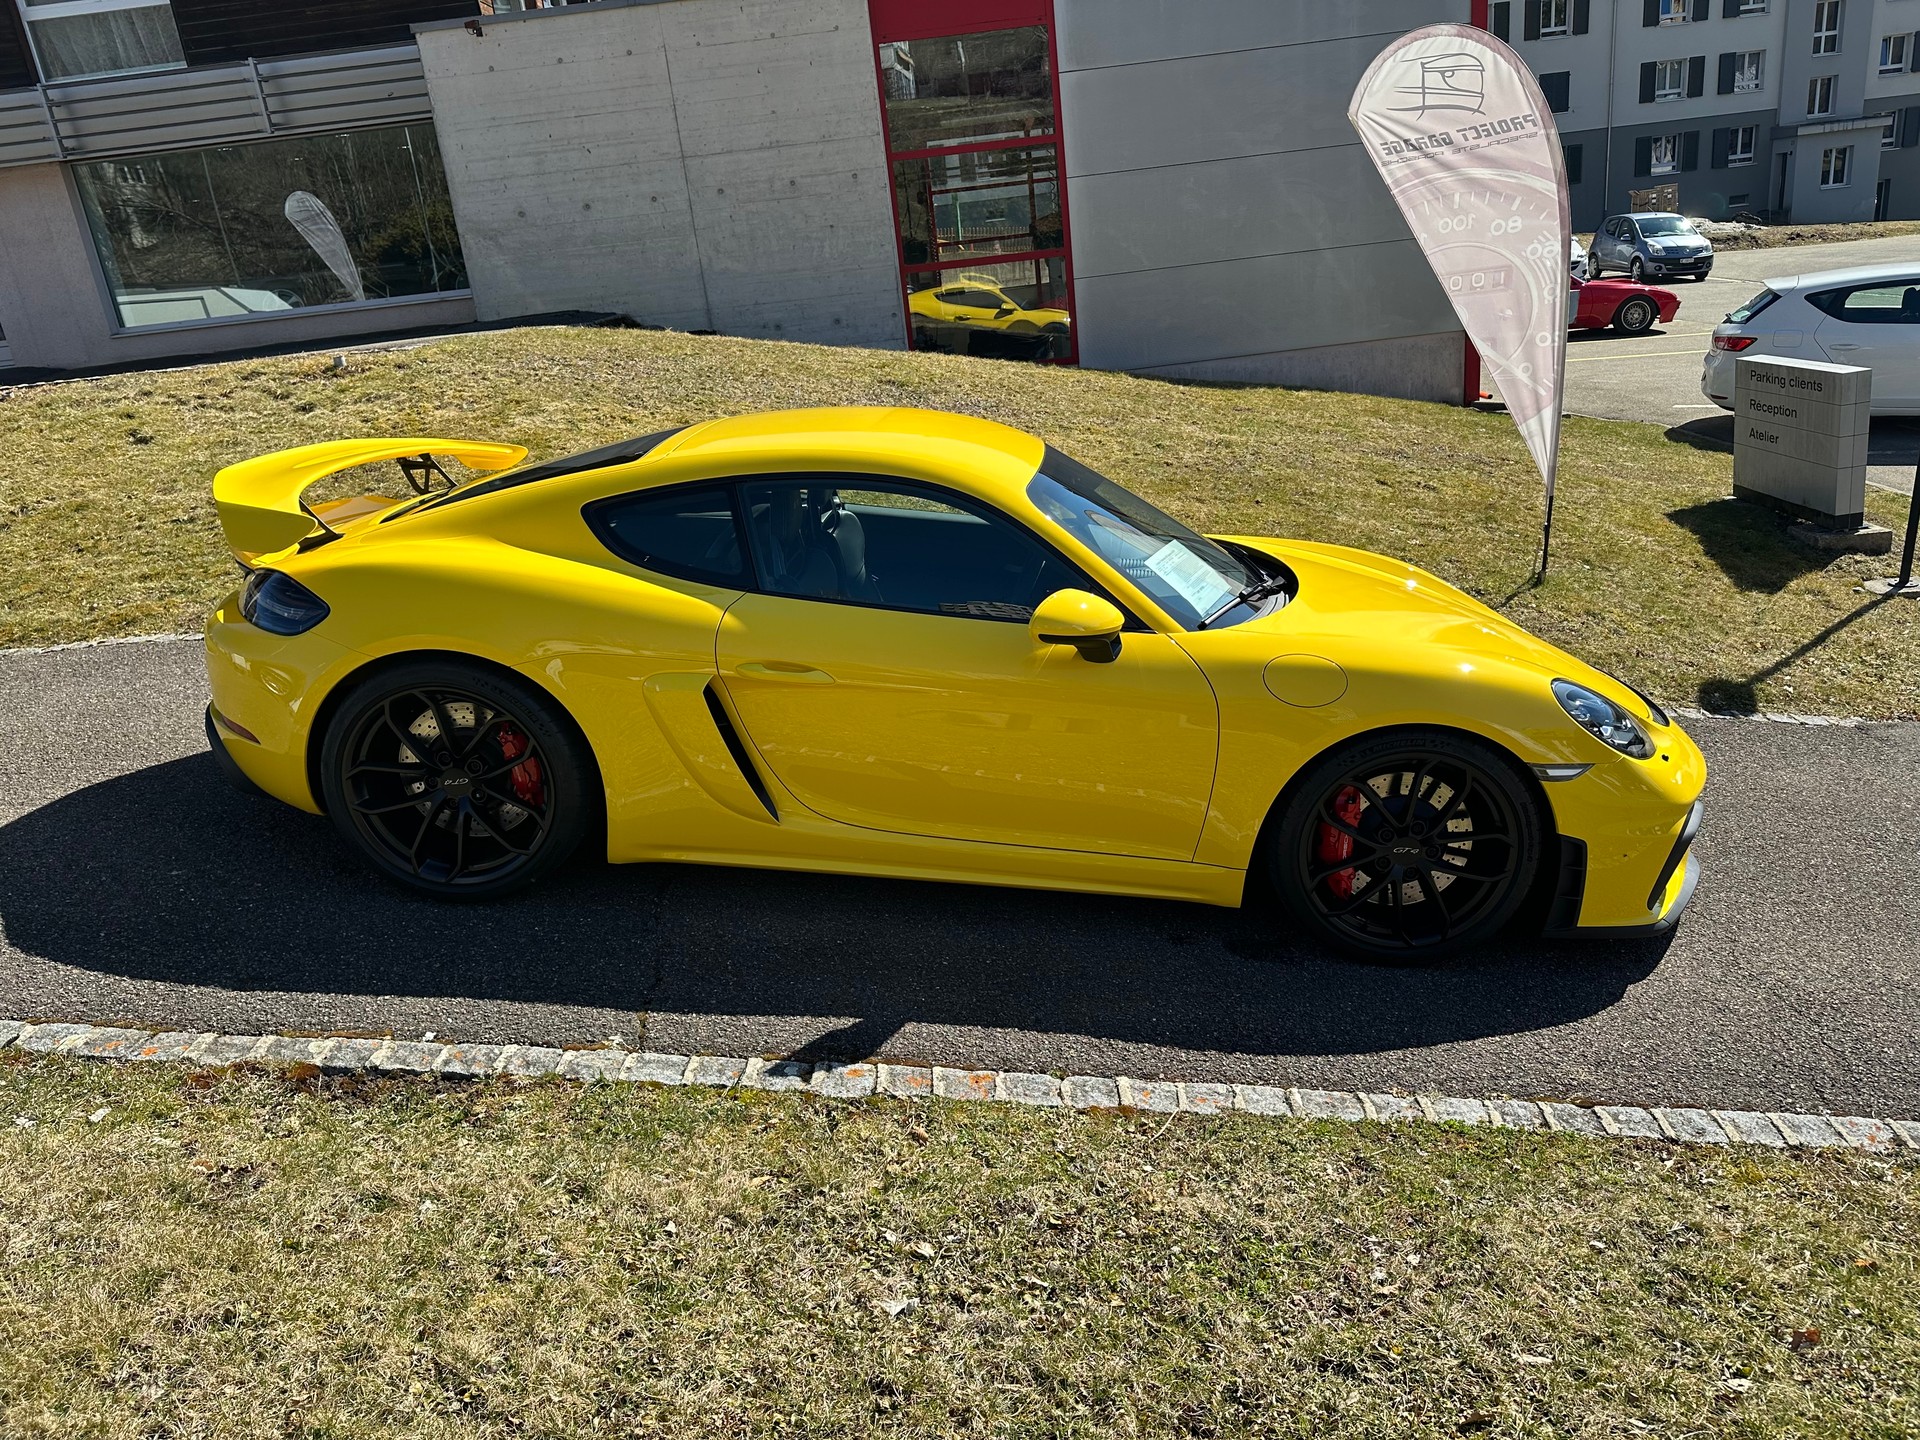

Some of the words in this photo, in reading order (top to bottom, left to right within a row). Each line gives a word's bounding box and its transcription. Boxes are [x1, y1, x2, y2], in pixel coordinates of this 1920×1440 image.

[1750, 369, 1786, 389] Parking
[1789, 375, 1823, 392] clients
[1749, 398, 1798, 418] Réception
[1749, 427, 1779, 444] Atelier
